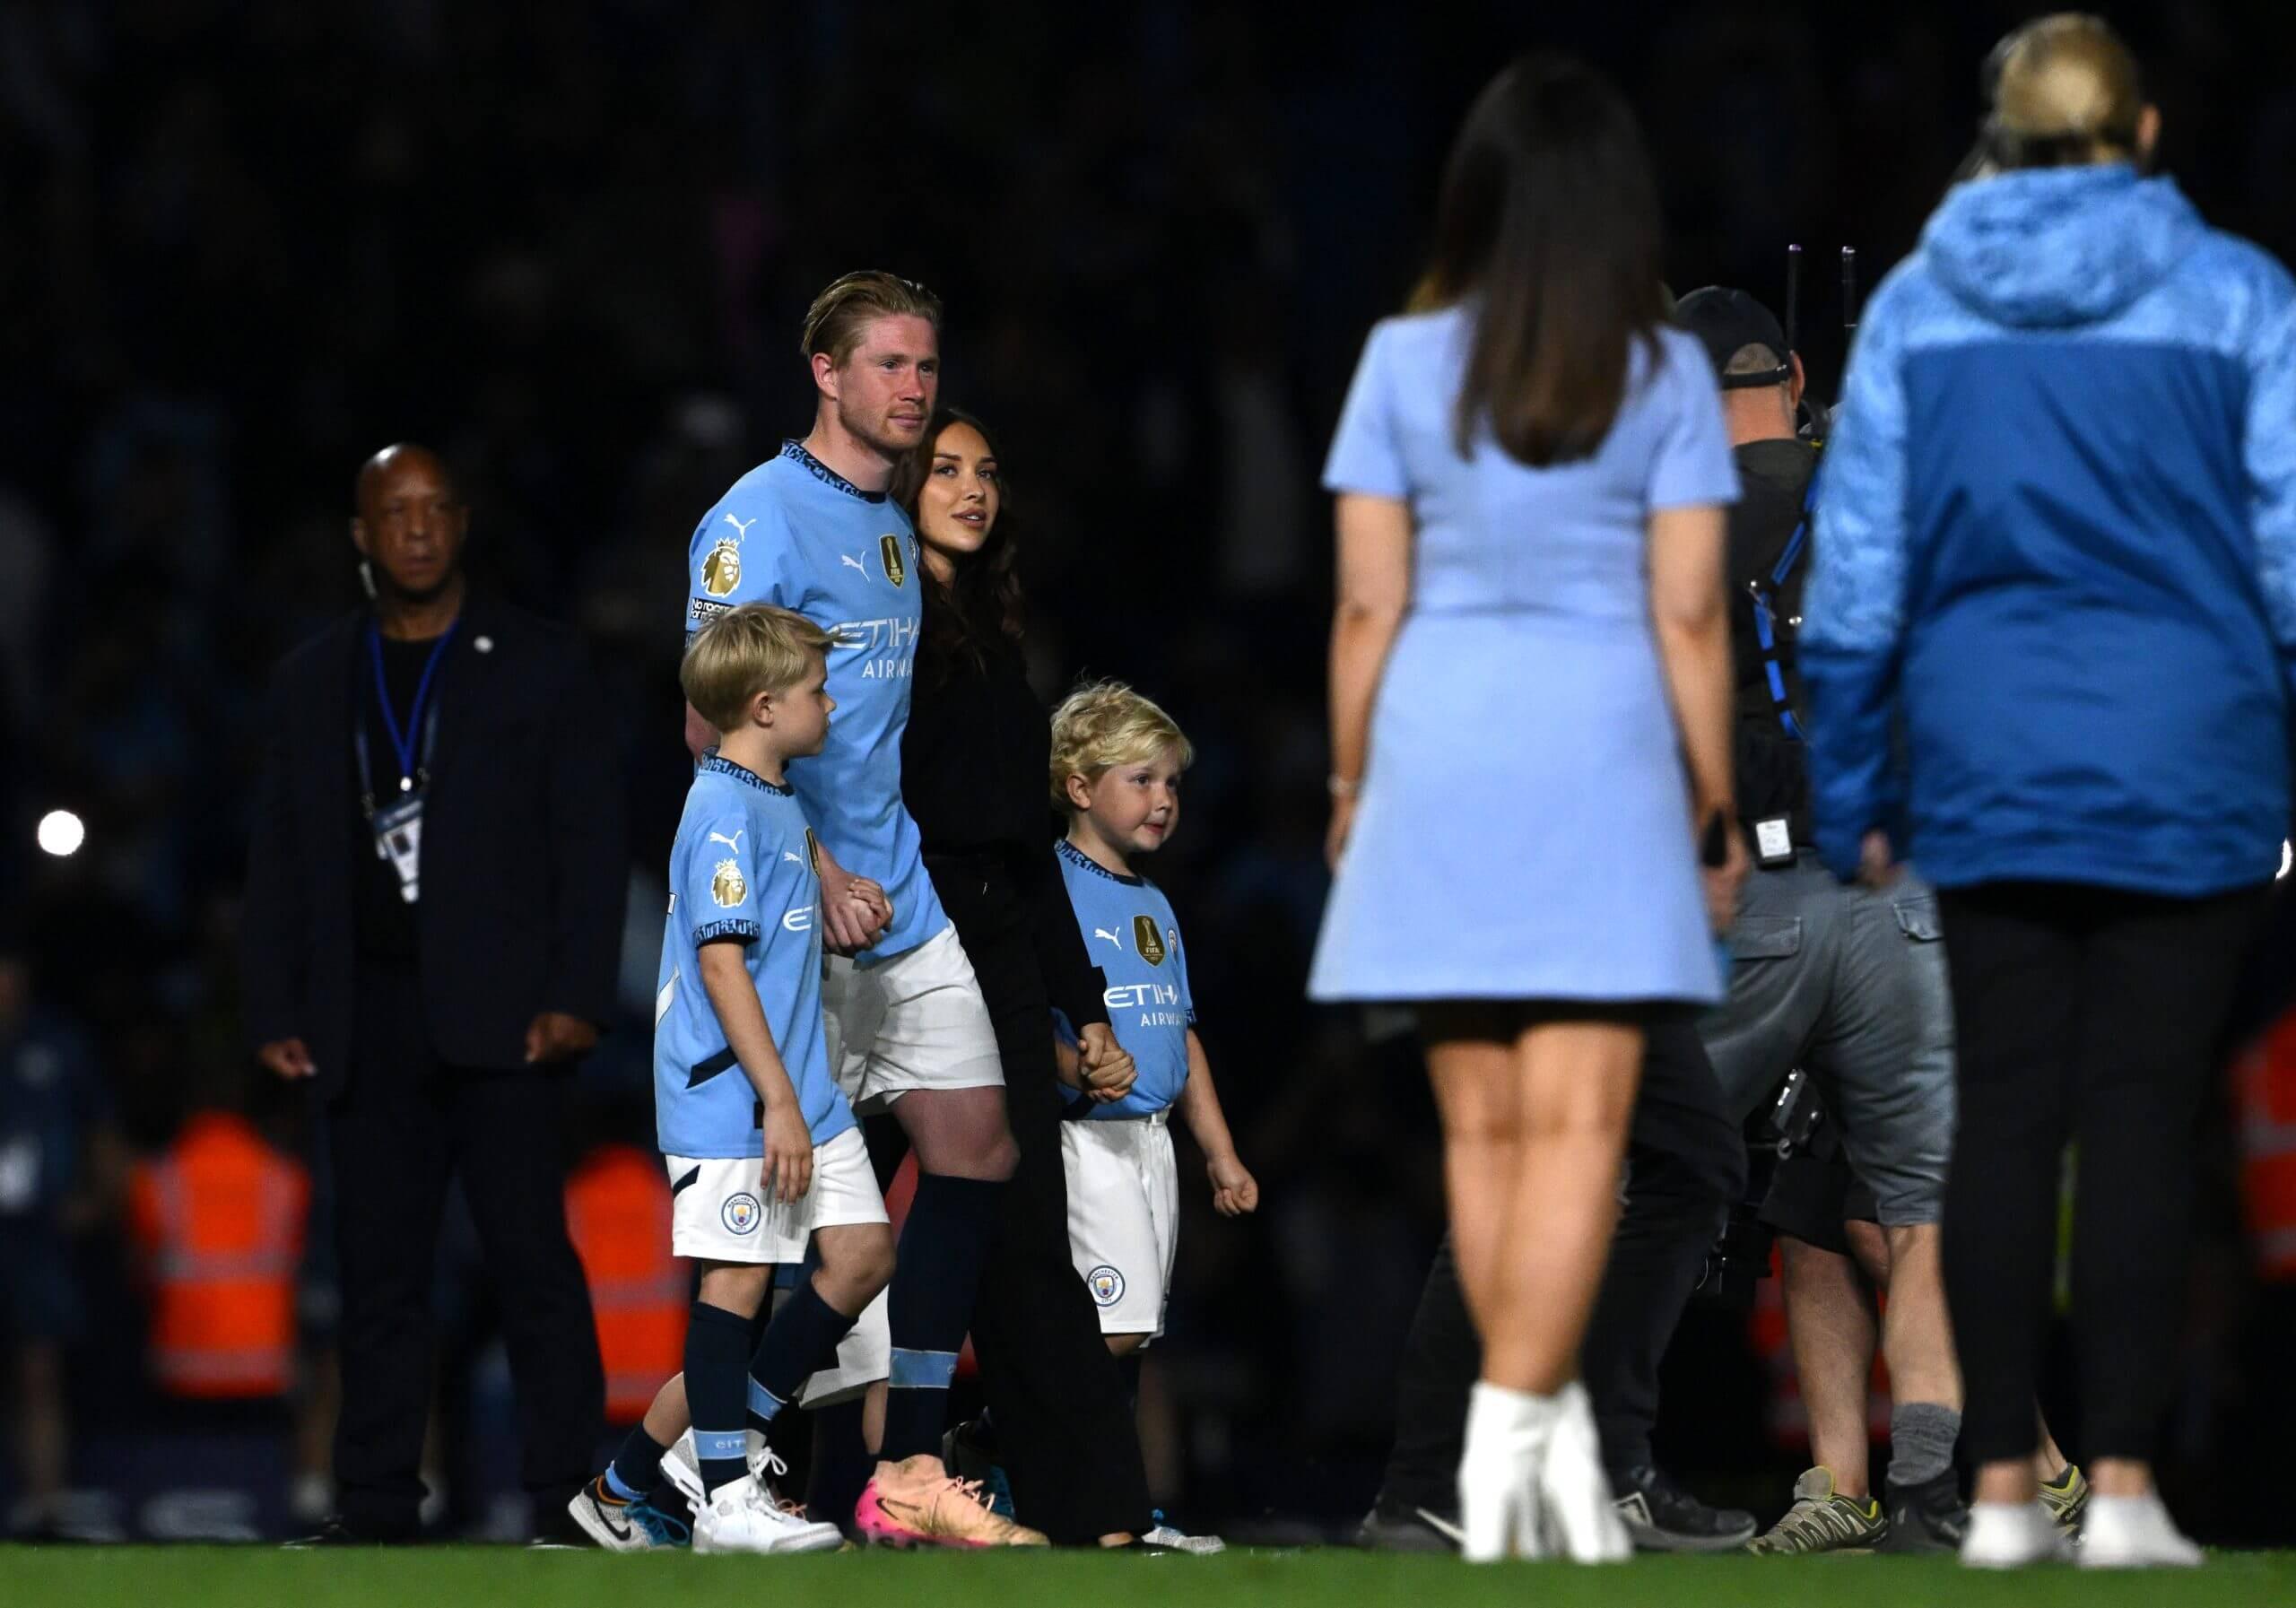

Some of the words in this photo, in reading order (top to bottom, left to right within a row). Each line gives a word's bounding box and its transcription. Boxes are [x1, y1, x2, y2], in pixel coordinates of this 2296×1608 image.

[691, 597, 703, 611] No
[828, 617, 919, 648] ETIHA
[862, 658, 913, 679] AIRWA
[1103, 984, 1178, 1008] ETIH
[1141, 1012, 1183, 1026] AIRWA
[716, 1439, 742, 1449] CIT
